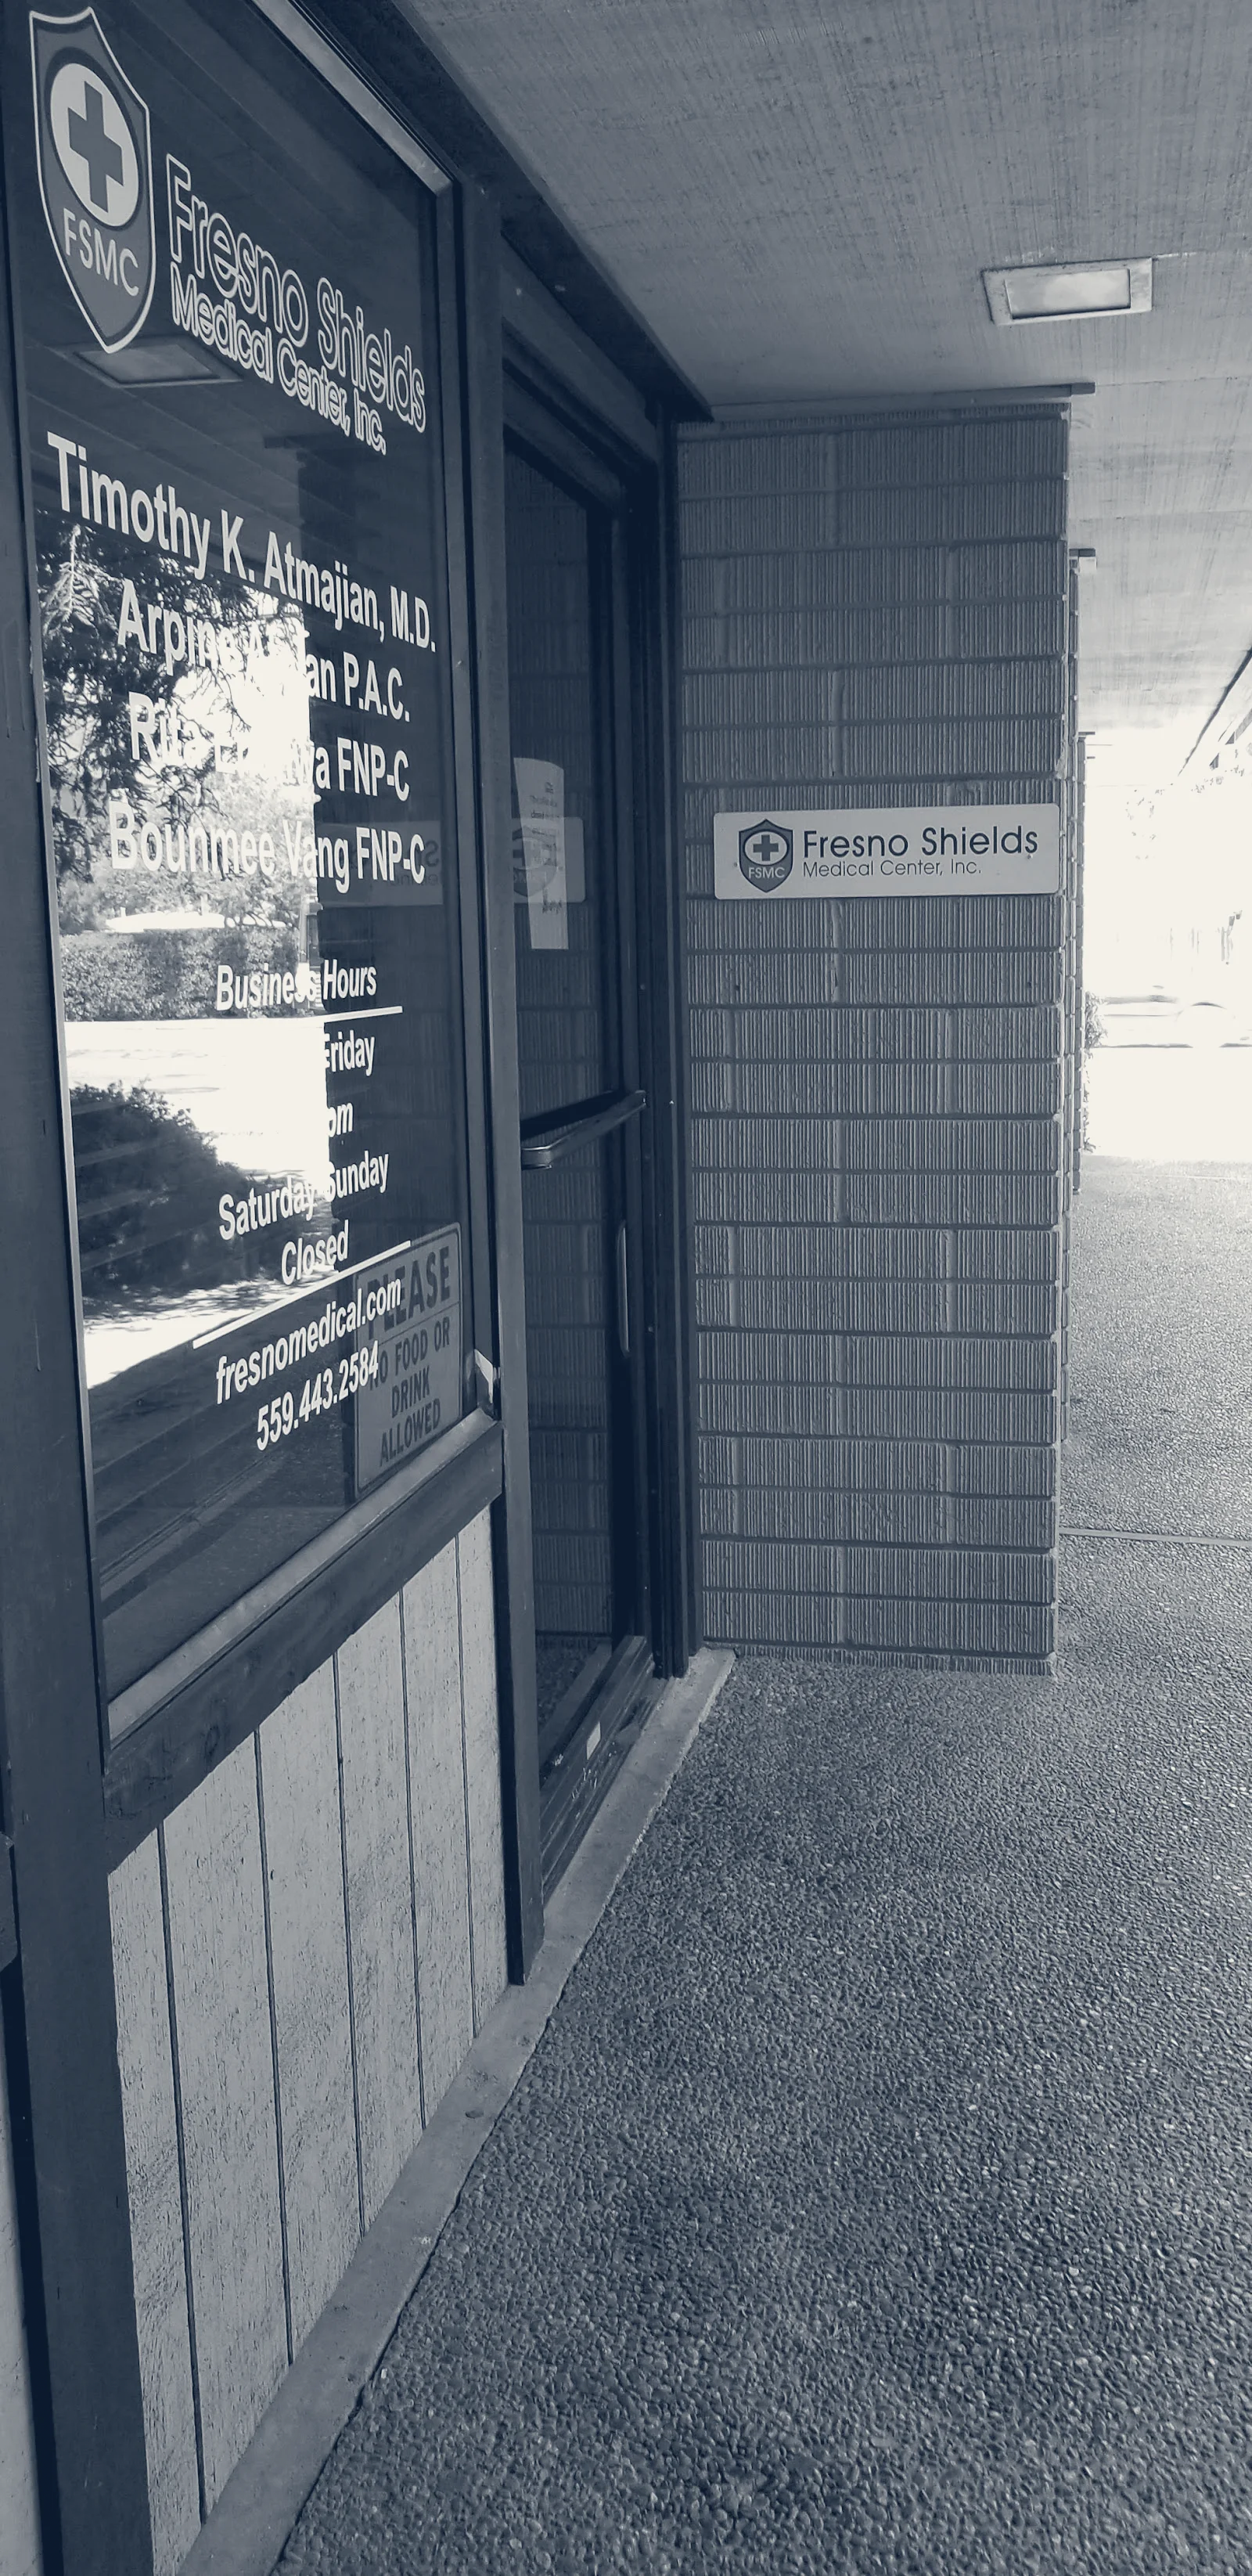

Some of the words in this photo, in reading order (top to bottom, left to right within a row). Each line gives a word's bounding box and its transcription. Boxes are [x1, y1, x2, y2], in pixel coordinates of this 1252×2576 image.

[63, 207, 140, 297] FSMC
[166, 153, 308, 348] Fresno
[316, 277, 426, 433] Shields
[170, 261, 274, 384] Medical
[277, 337, 350, 437] Center,
[354, 389, 387, 456] Inc.
[47, 431, 210, 580] Timothy
[221, 509, 256, 583] K.
[264, 531, 386, 643] Atmajian,
[390, 585, 437, 652] M.D.
[117, 577, 243, 678] Arpine
[344, 652, 410, 722] P.A.C.
[336, 736, 410, 802] FNP-C
[109, 798, 275, 877] Bounmee
[282, 819, 350, 893] Vang
[356, 827, 426, 884] FNP-C
[748, 866, 786, 880] FSMC
[803, 830, 908, 858] Fresno
[922, 826, 1038, 855] Shields
[803, 860, 874, 877] Medical
[880, 859, 943, 876] Center,
[951, 859, 982, 875] Inc.
[322, 959, 377, 1000] Hours
[218, 1174, 315, 1241] Saturday
[281, 1219, 350, 1285] Closed
[368, 1245, 450, 1341] PLEASE
[216, 1278, 401, 1404] fresnomedical.com
[395, 1328, 428, 1377] FOOD
[434, 1316, 450, 1352] OR
[256, 1340, 379, 1451] 559.443.2584
[392, 1364, 430, 1419] DRINK
[380, 1398, 441, 1468] ALLOWED
